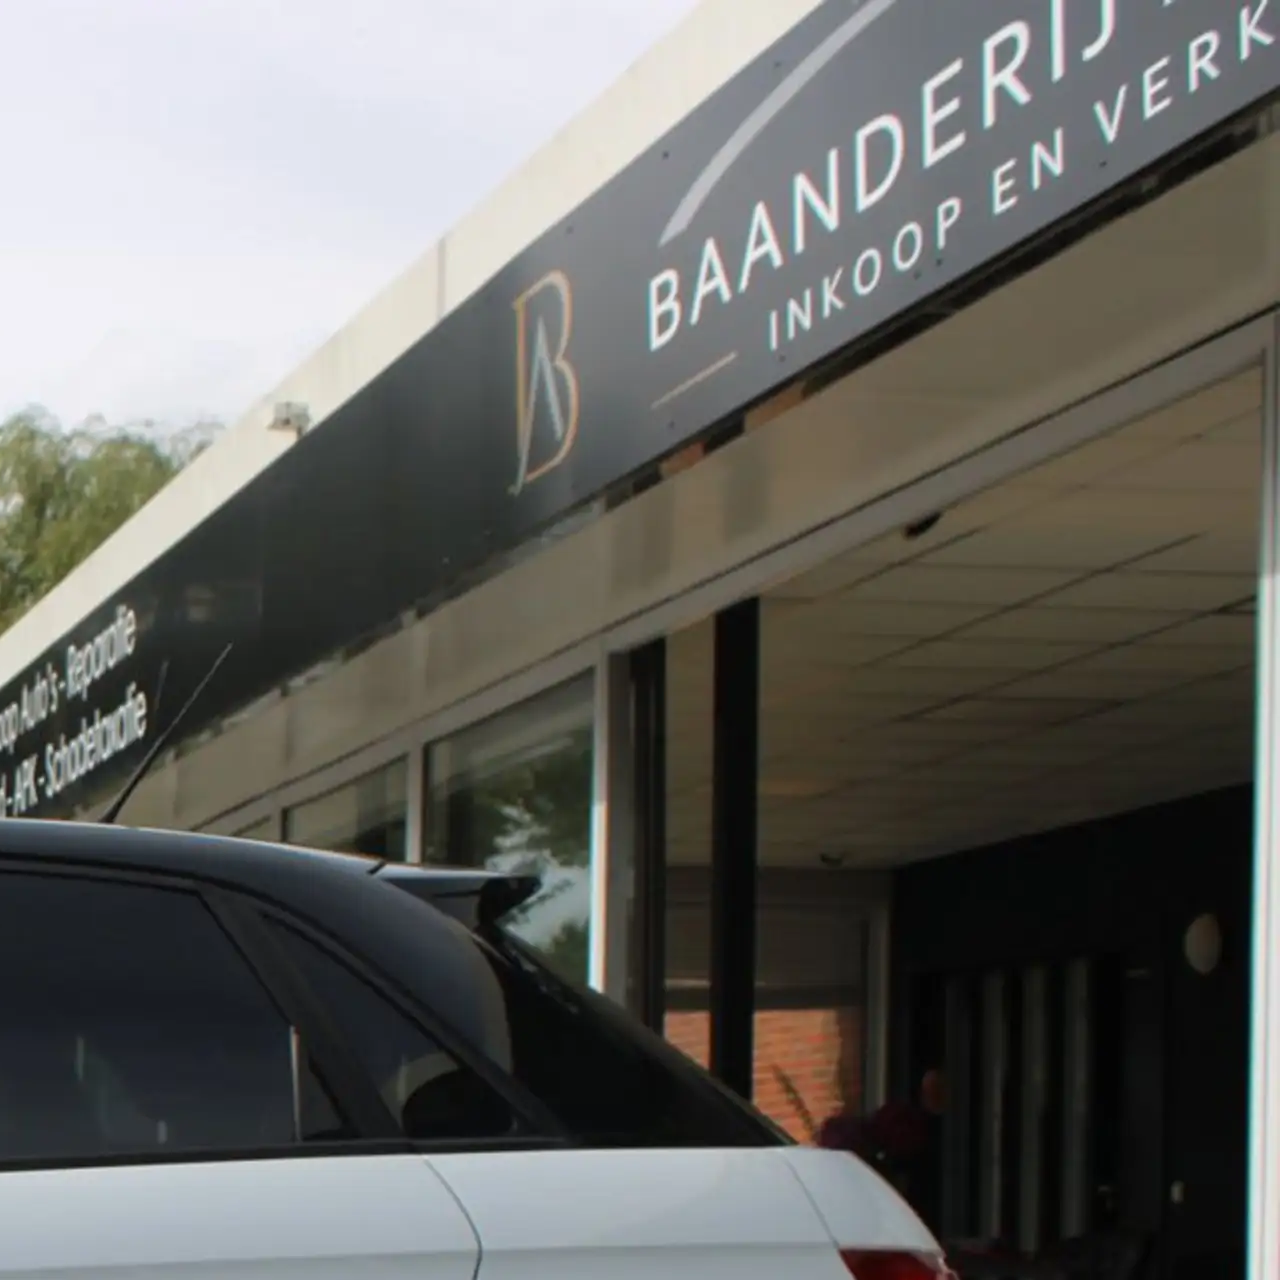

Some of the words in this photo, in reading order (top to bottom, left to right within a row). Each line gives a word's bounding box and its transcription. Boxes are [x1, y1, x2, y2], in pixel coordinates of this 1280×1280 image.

[649, 0, 1115, 351] BAANDERIJ
[769, 197, 962, 350] INKOOP
[992, 128, 1064, 215] EN
[1093, 0, 1276, 144] VERK
